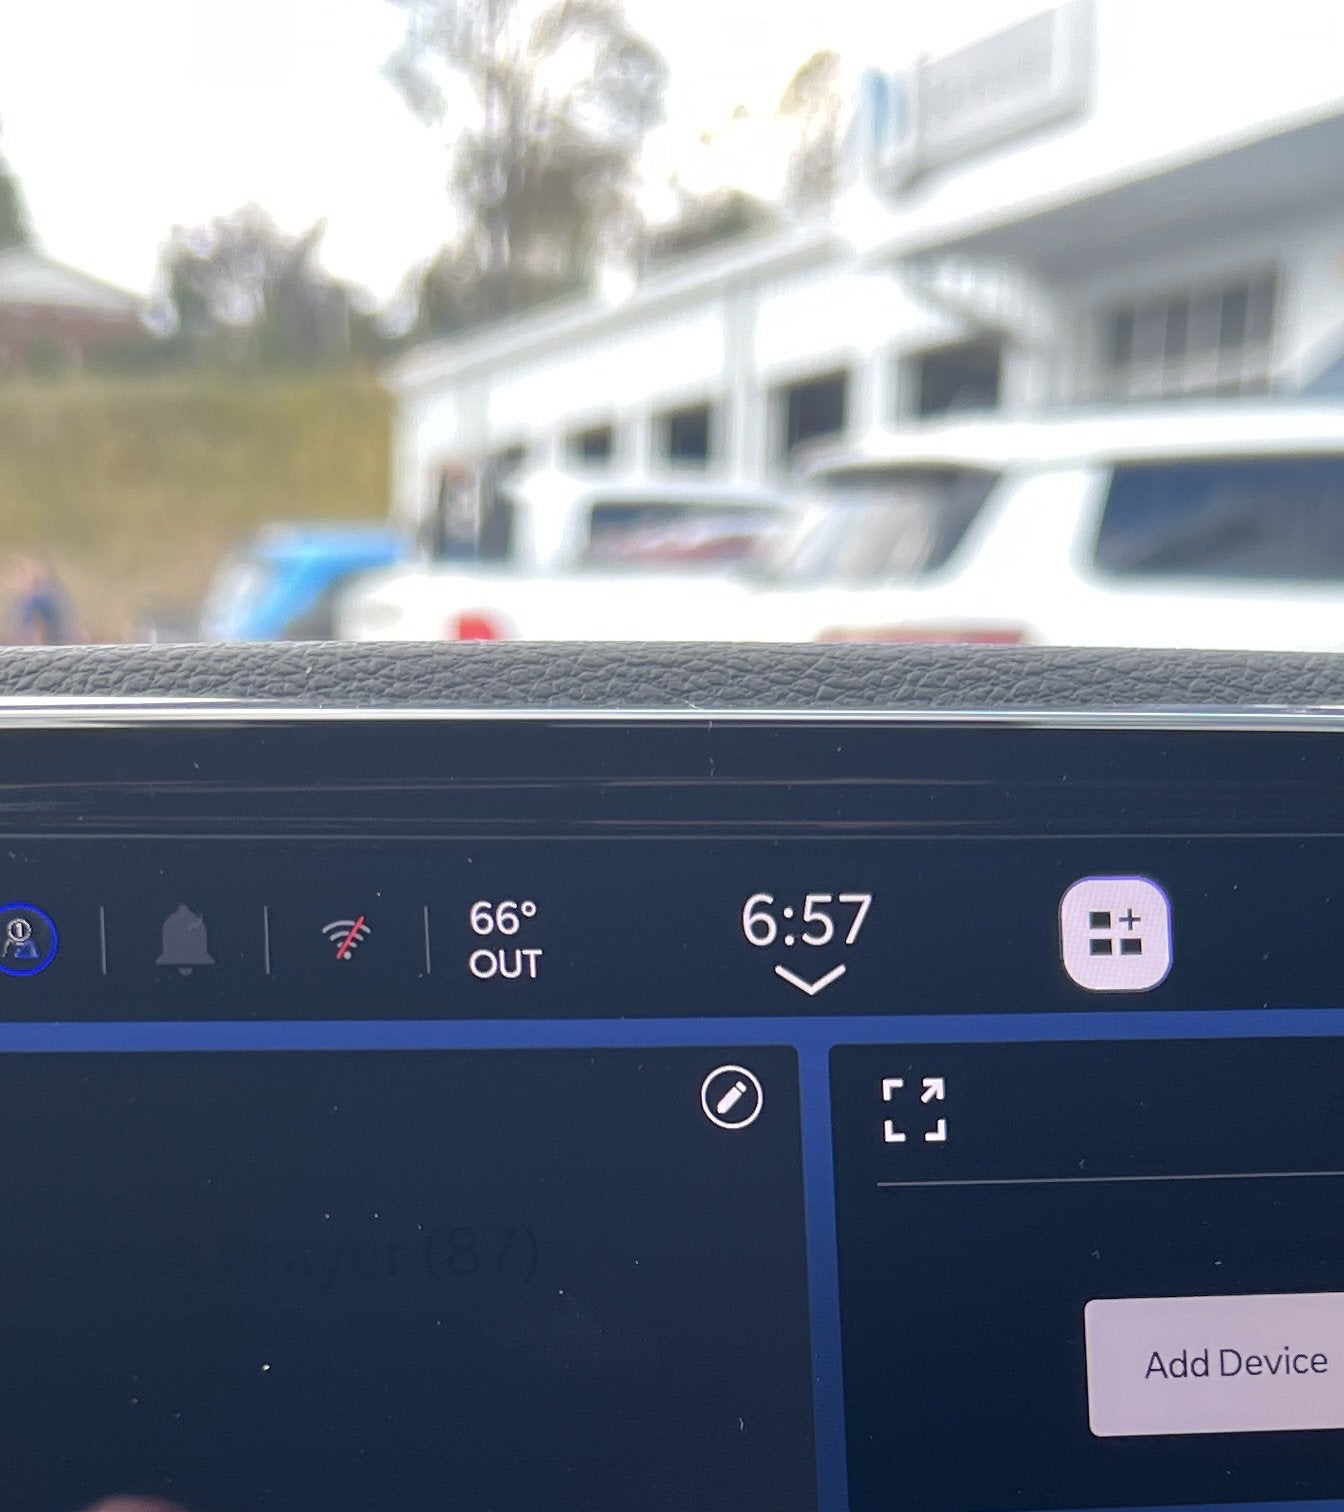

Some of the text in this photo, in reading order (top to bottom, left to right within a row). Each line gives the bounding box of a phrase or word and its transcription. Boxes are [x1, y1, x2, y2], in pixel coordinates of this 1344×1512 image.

[470, 901, 537, 935] 66°
[742, 893, 872, 946] 6:57
[469, 949, 543, 979] OUT
[422, 1222, 541, 1284] (87)
[1145, 1345, 1328, 1379] Add Device
